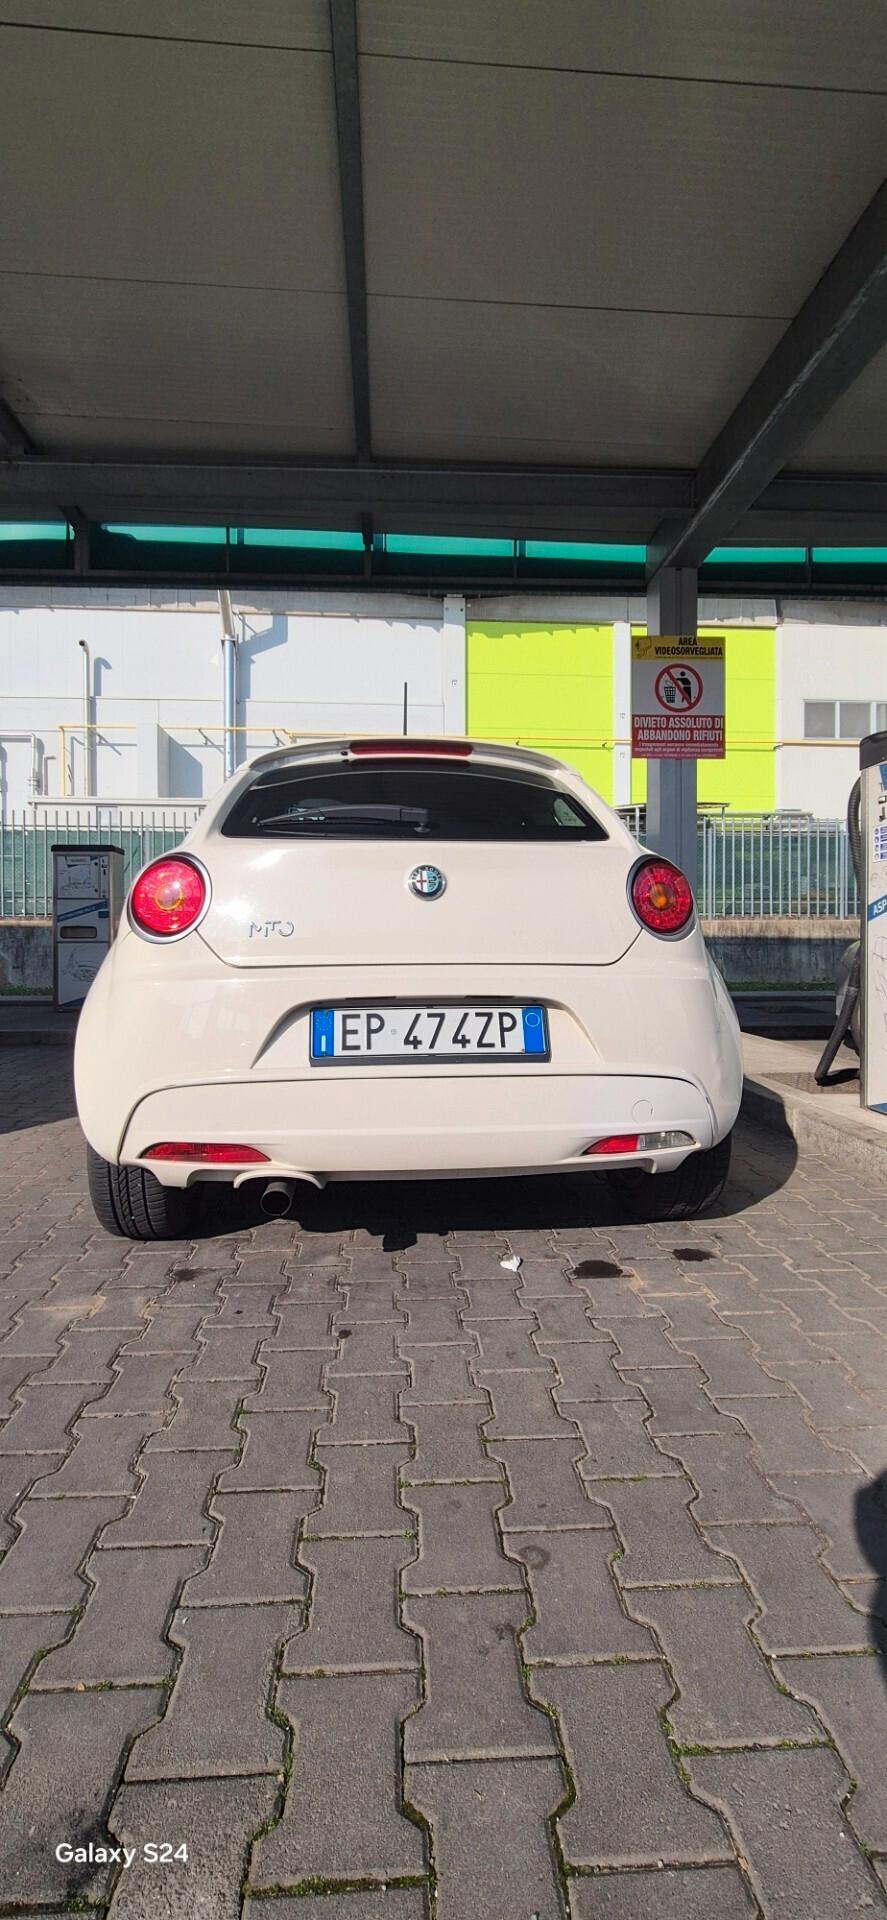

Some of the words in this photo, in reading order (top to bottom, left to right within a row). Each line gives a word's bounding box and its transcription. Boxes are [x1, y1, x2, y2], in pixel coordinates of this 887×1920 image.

[678, 637, 697, 646] AREA
[655, 646, 723, 656] VIDEOSORVEGLIATA
[634, 717, 667, 729] DIVIETO
[668, 717, 712, 729] ASSOLUTO
[714, 717, 724, 729] DI
[638, 730, 691, 741] ABBANDONO
[693, 730, 723, 741] RIFIUTI
[341, 1013, 386, 1051] EP
[403, 1012, 517, 1050] 474ZP
